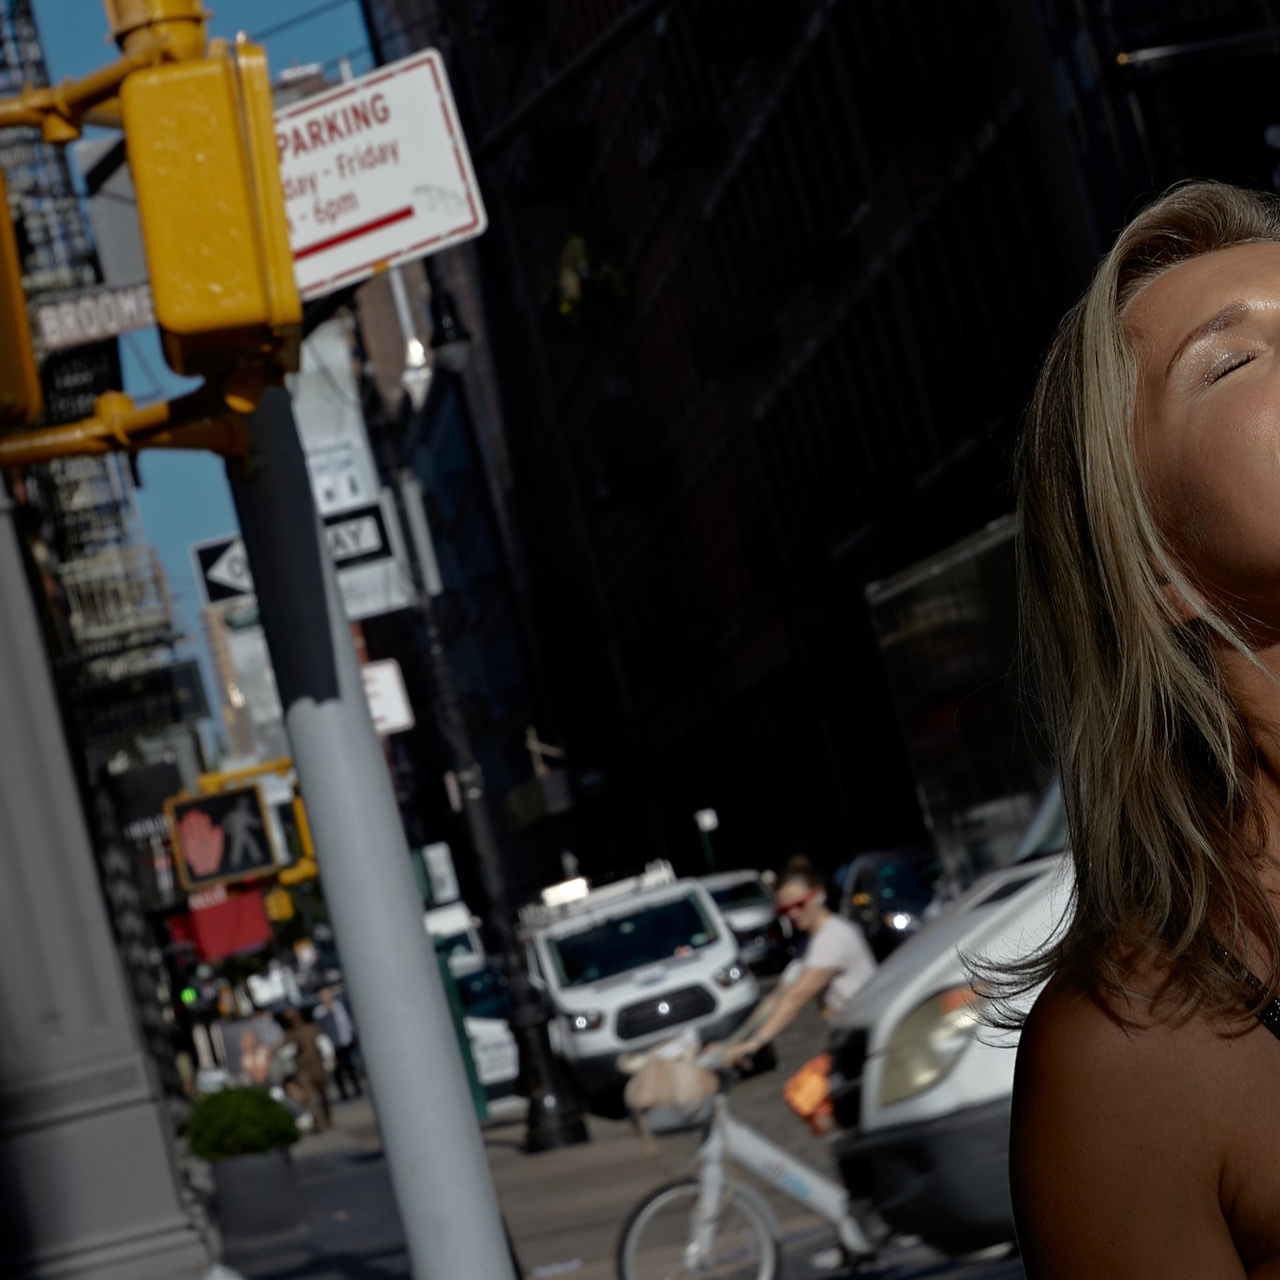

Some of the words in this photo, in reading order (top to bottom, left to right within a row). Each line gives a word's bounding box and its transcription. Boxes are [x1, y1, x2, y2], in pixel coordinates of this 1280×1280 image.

[276, 93, 390, 164] PARKING
[335, 139, 399, 180] Friday
[313, 192, 359, 224] 6pm
[330, 524, 363, 553] AY
